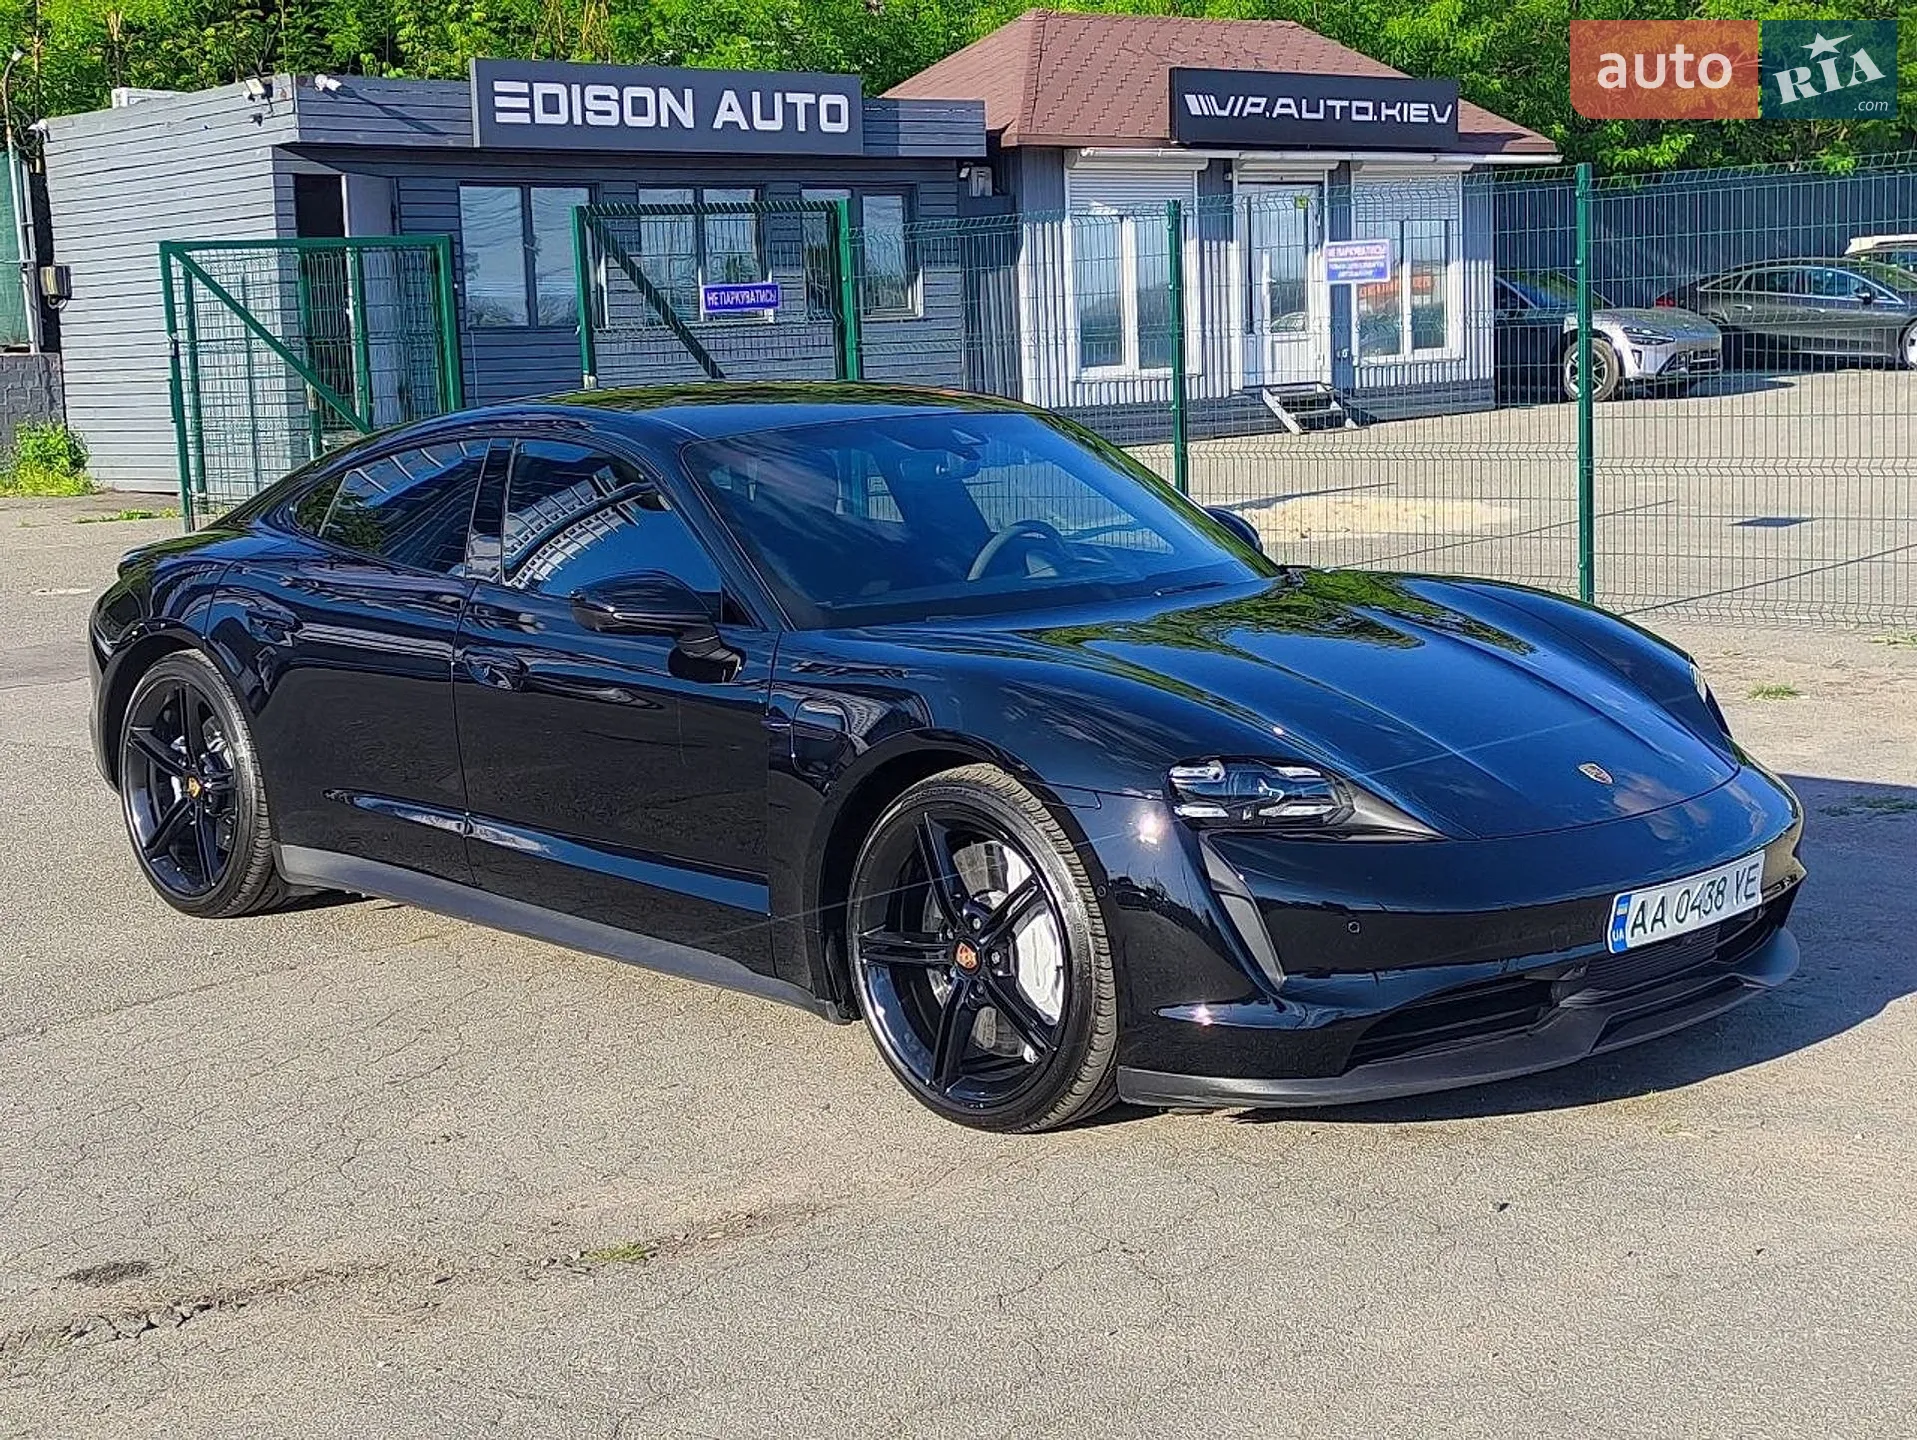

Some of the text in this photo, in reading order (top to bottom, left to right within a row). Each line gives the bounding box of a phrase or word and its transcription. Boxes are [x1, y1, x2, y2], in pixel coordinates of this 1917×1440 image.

[492, 80, 850, 133] EDISON AUTO
[706, 291, 719, 306] НЕ
[1630, 863, 1760, 938] AA 0438 YE
[1612, 929, 1625, 941] UA
